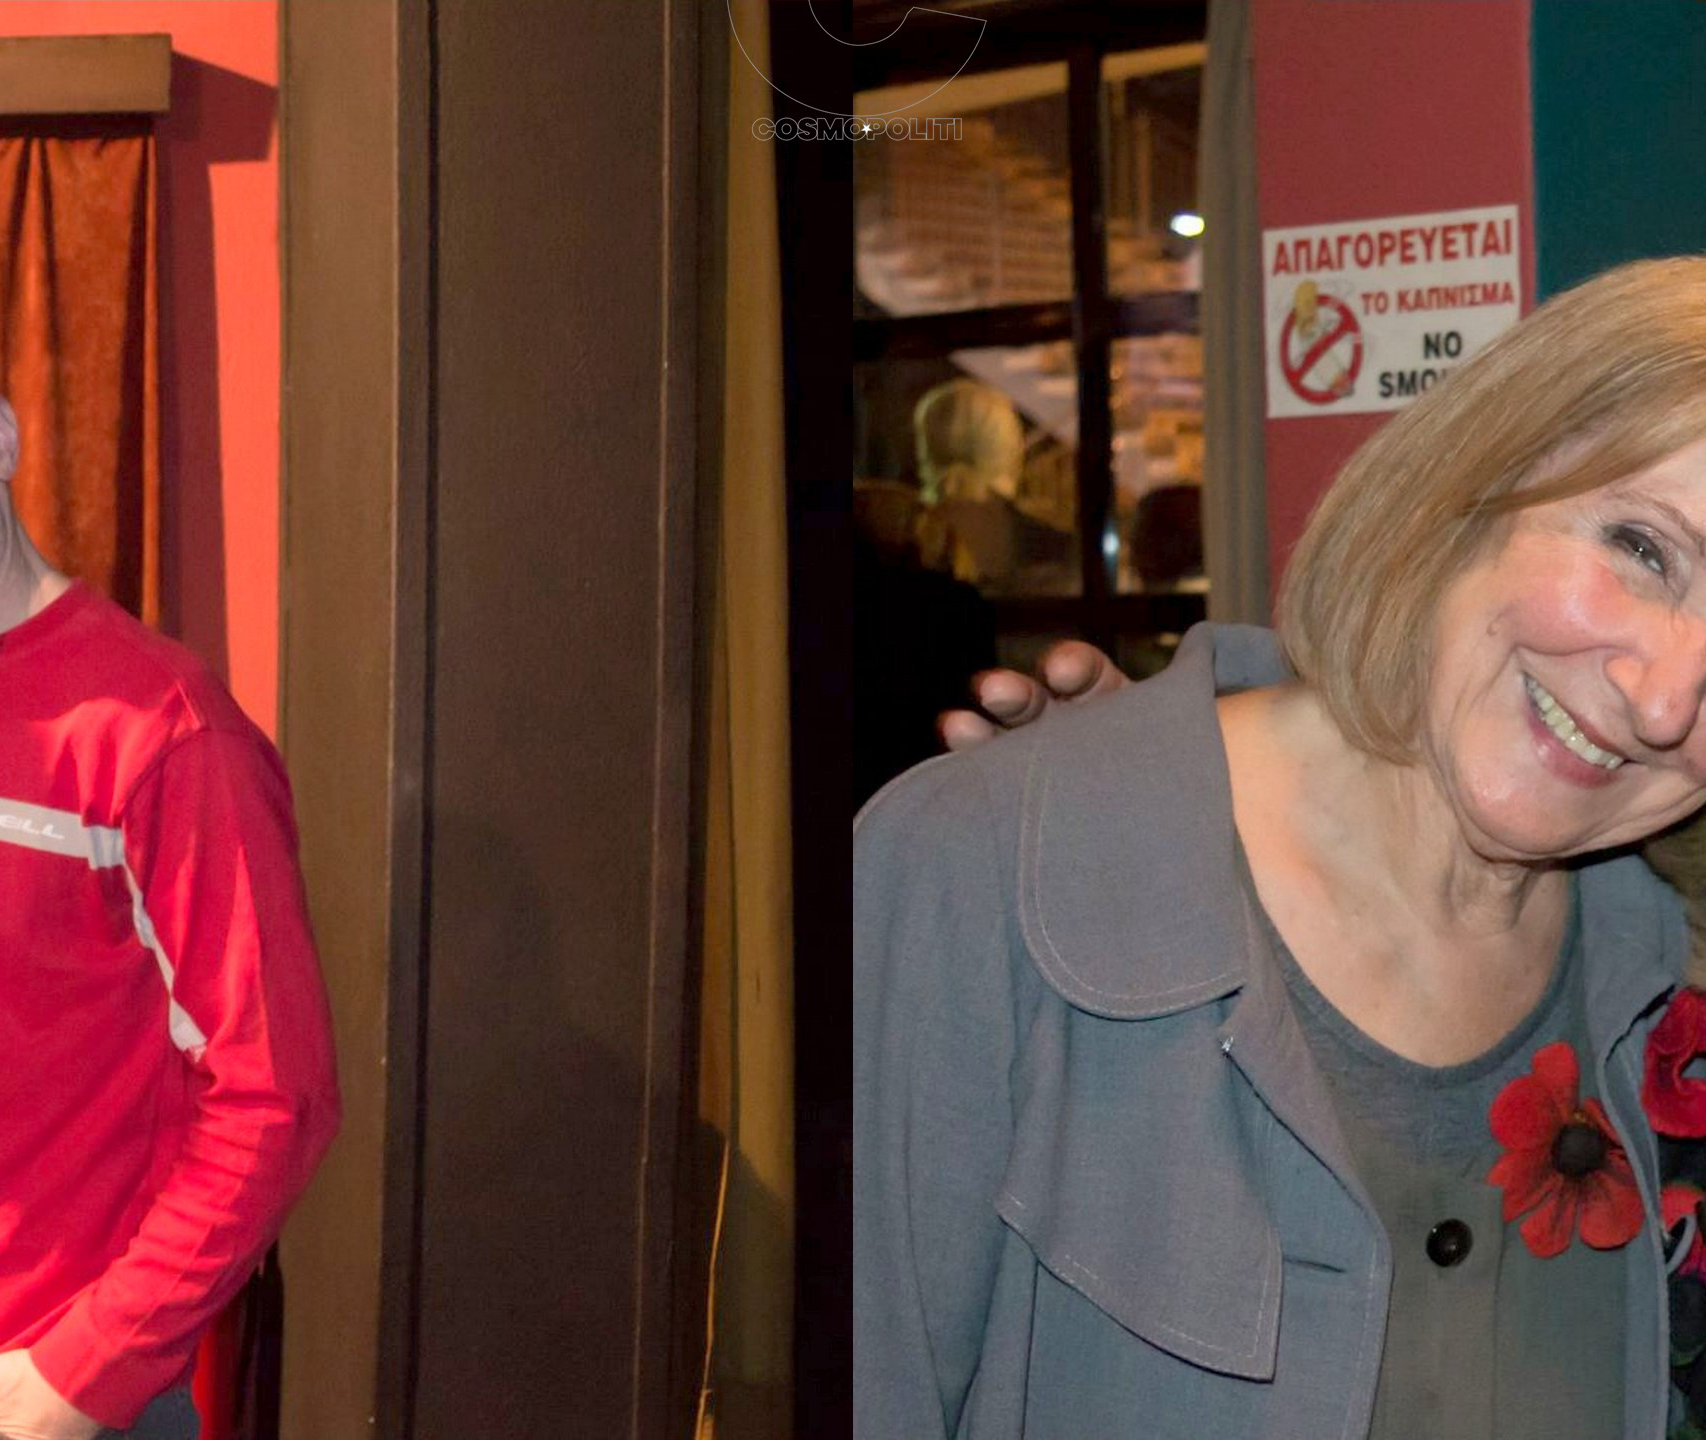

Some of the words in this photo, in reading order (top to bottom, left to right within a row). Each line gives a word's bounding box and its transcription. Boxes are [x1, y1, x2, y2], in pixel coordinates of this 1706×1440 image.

[1273, 219, 1513, 276] ΑΠΑΓΟΡΕΥΕΤΑΙ
[1361, 290, 1389, 316] ΤΟ
[1397, 282, 1515, 314] ΚΑΠΝΙΣΜΑ
[1423, 331, 1463, 360] NO
[1379, 368, 1447, 398] SMO
